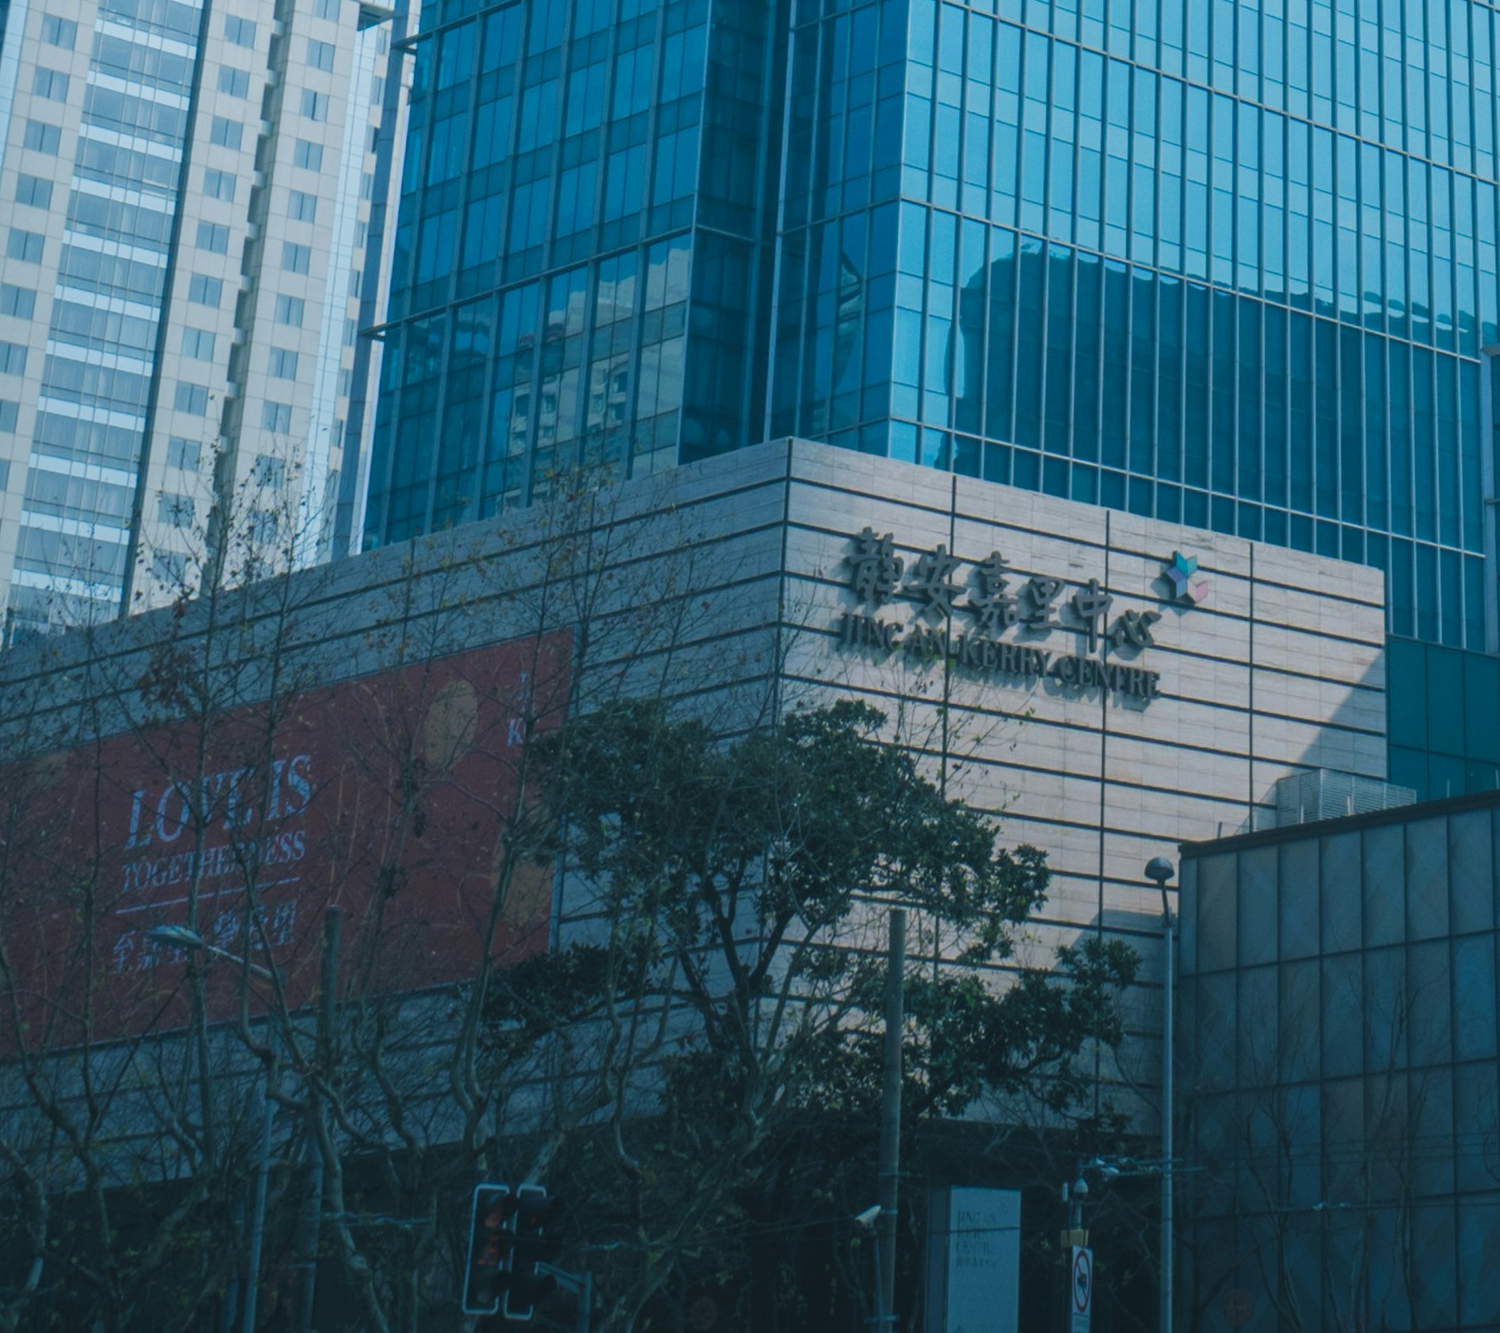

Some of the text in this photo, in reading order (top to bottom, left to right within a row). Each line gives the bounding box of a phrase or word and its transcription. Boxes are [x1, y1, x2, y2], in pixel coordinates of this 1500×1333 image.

[911, 624, 948, 657] AN
[957, 633, 1053, 677] KERRY
[1059, 655, 1162, 697] CENTRE
[124, 753, 312, 852] LOVE IS
